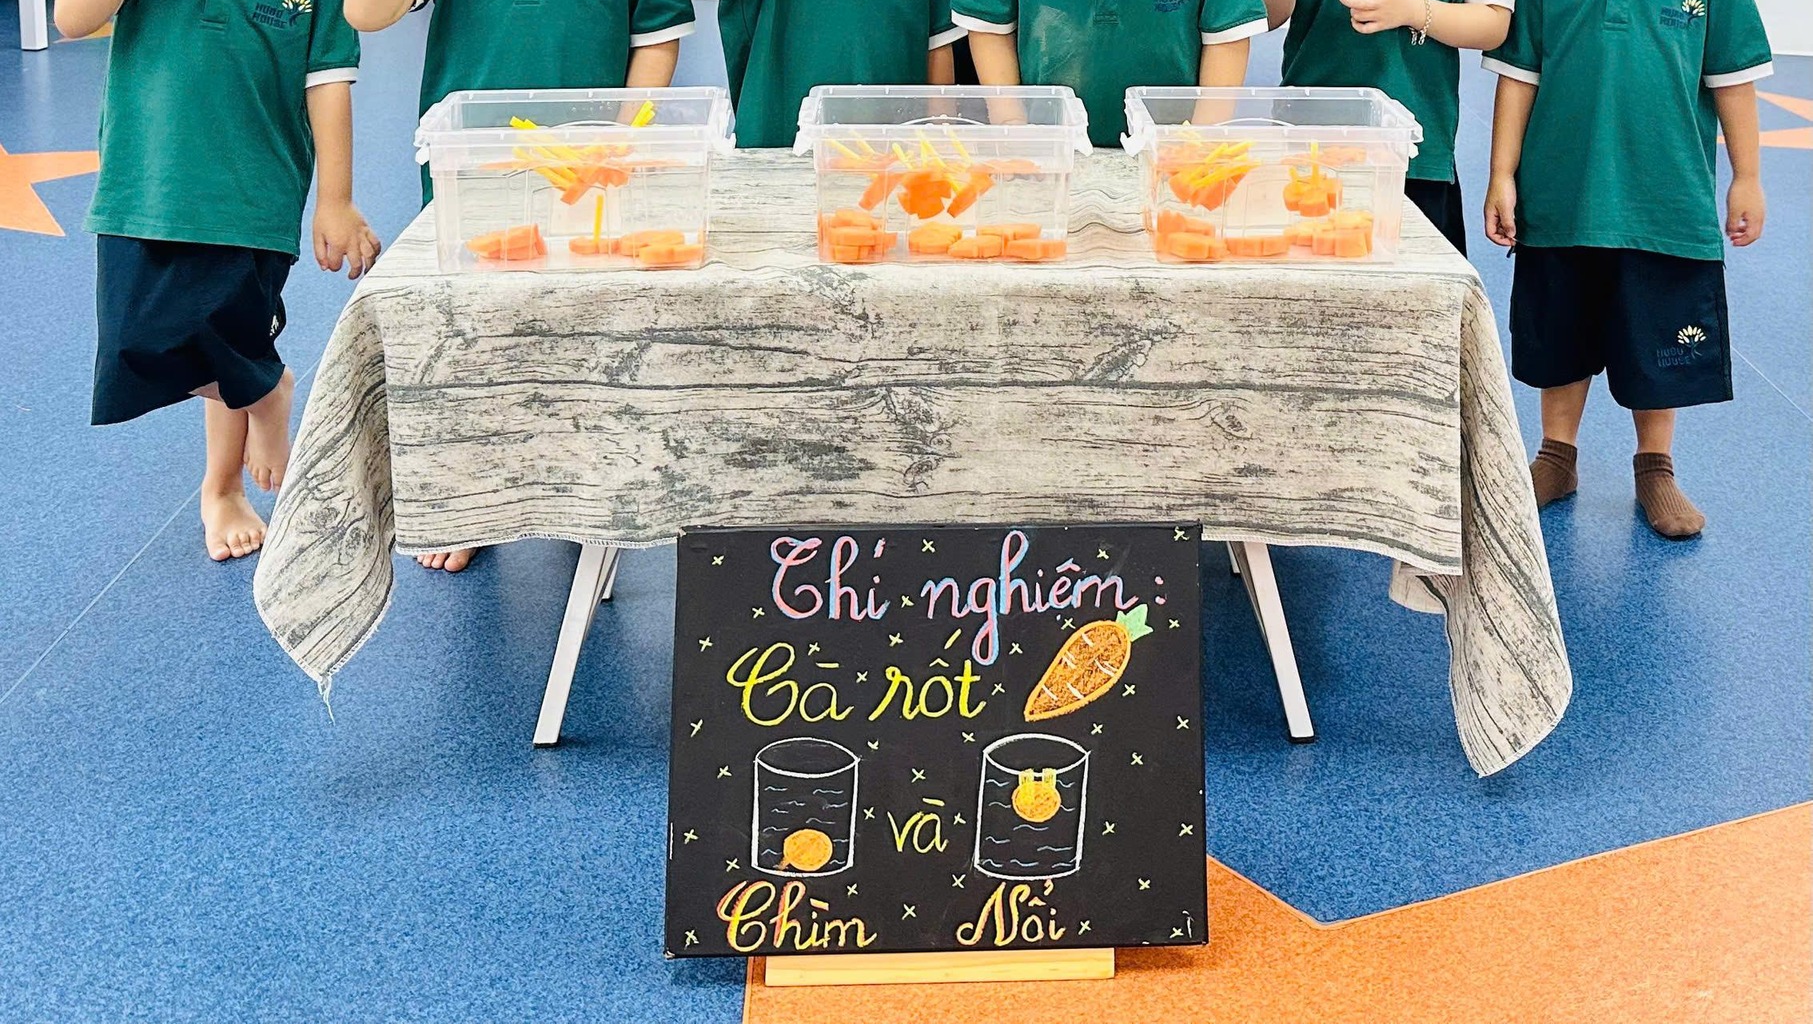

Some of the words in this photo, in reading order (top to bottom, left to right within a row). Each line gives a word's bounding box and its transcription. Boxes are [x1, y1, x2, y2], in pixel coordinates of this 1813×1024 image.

[770, 535, 891, 622] Thí
[867, 628, 987, 721] rốt
[886, 796, 949, 854] và
[716, 880, 878, 952] Chìm
[956, 878, 1067, 947] Nổi
